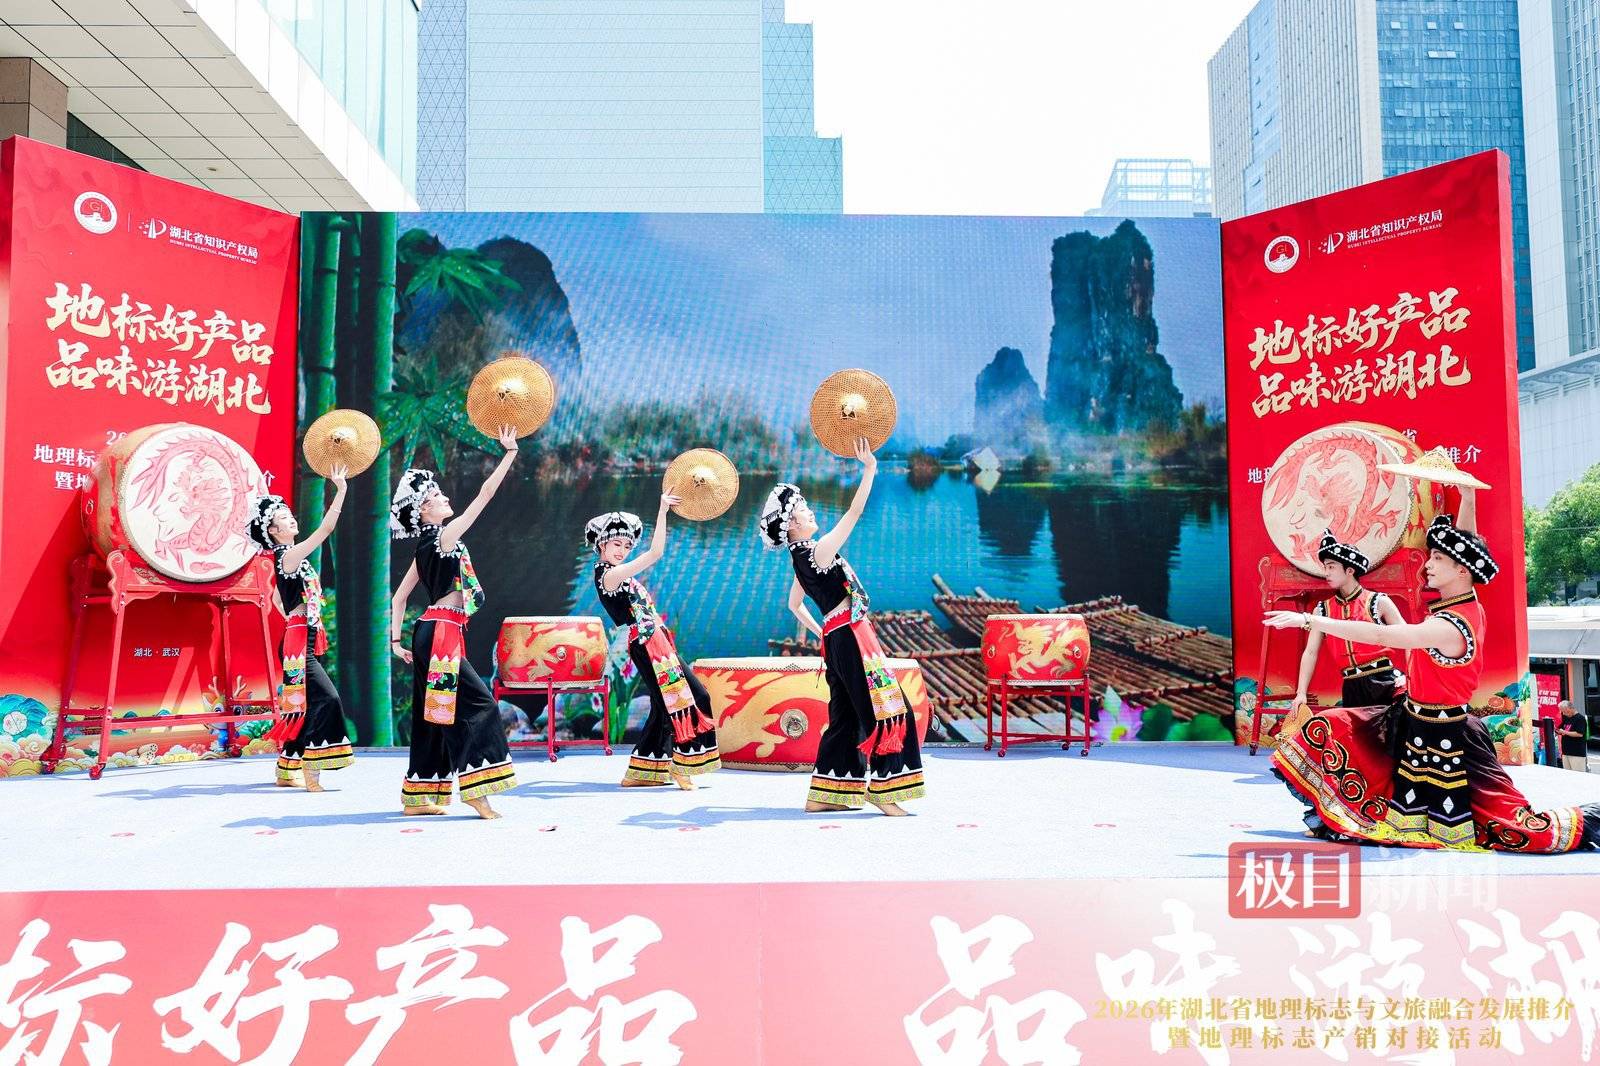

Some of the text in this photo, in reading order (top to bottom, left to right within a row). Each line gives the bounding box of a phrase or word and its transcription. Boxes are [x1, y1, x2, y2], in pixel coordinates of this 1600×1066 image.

[169, 226, 258, 259] 湖北省知识产权局
[1346, 209, 1443, 243] 湖北省知识产权局
[45, 282, 275, 366] 地标好产品
[1248, 287, 1471, 371] 地标好产品
[45, 338, 272, 415] 品味游湖北
[1251, 344, 1472, 418] 品味游湖北
[33, 443, 102, 469] 地理标
